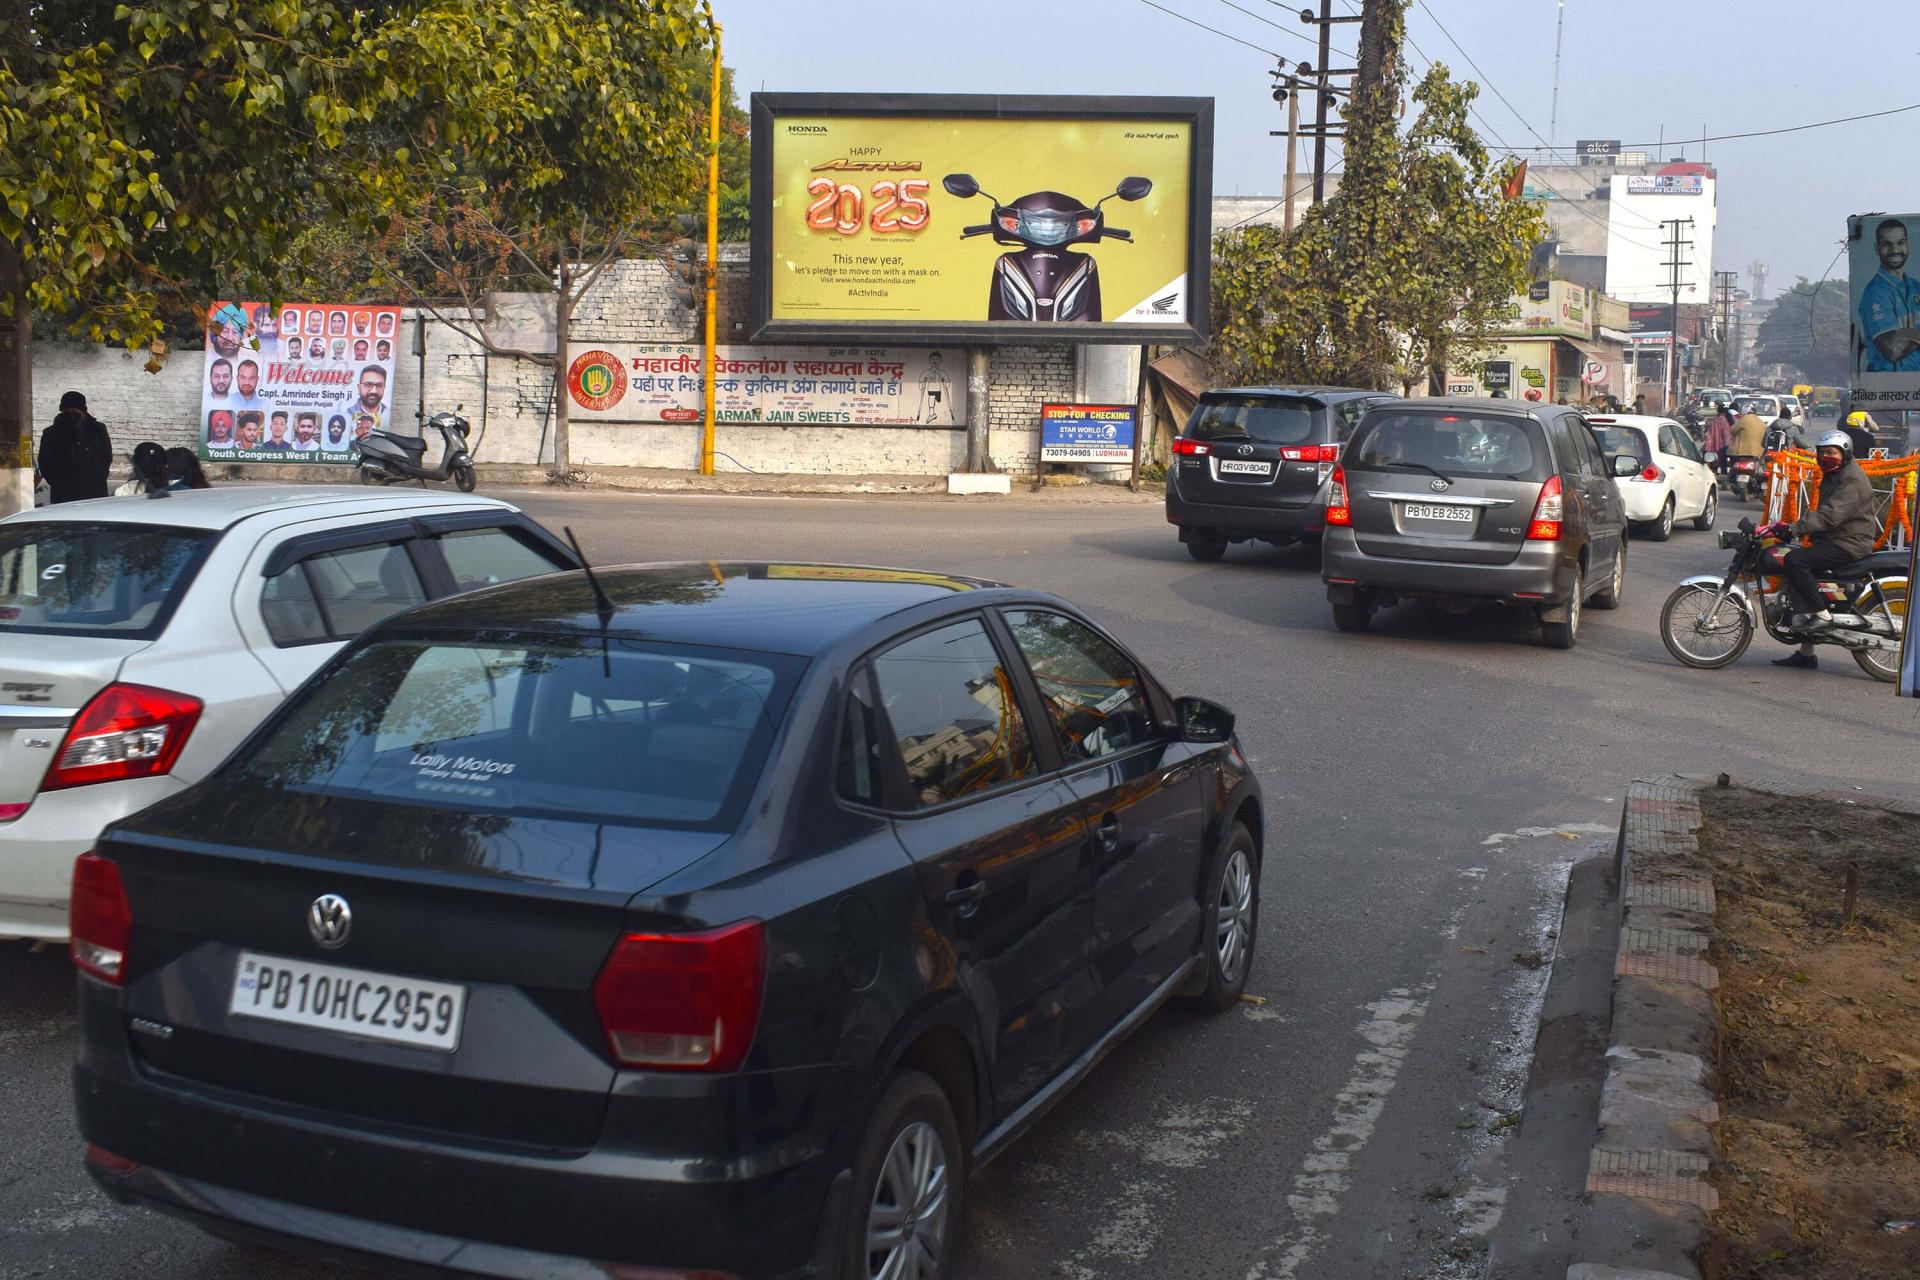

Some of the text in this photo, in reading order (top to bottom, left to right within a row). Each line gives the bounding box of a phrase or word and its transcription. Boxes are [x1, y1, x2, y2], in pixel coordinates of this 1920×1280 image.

[850, 148, 882, 156] HAPPY
[1587, 142, 1610, 153] akc
[832, 254, 904, 267] This new year,
[795, 266, 811, 275] let's
[812, 267, 837, 276] pledge
[835, 277, 916, 285] www.hondaactivindia.com
[848, 289, 889, 298] #ActivIndia
[632, 354, 702, 374] महावीर
[793, 360, 863, 376] सहायता
[867, 357, 906, 380] केन्द्र
[267, 362, 354, 385] Welcome
[657, 378, 675, 392] पर
[791, 377, 818, 394] अंग
[821, 378, 857, 395] लगाये
[860, 378, 884, 395] जाते
[258, 389, 353, 401] Capt. Amrinder Singh ji
[699, 410, 761, 422] SARMAN
[766, 411, 794, 421] JAIN
[798, 411, 850, 423] SWEETS
[1048, 410, 1130, 420] STOP FOR CHECKING
[208, 450, 236, 458] Youth
[237, 450, 283, 461] Congress
[285, 451, 310, 460] West
[322, 452, 348, 461] Team
[1046, 449, 1091, 457] 73079-04905
[409, 753, 517, 775] Lally Motors
[253, 966, 455, 1036] PB10HC2959
